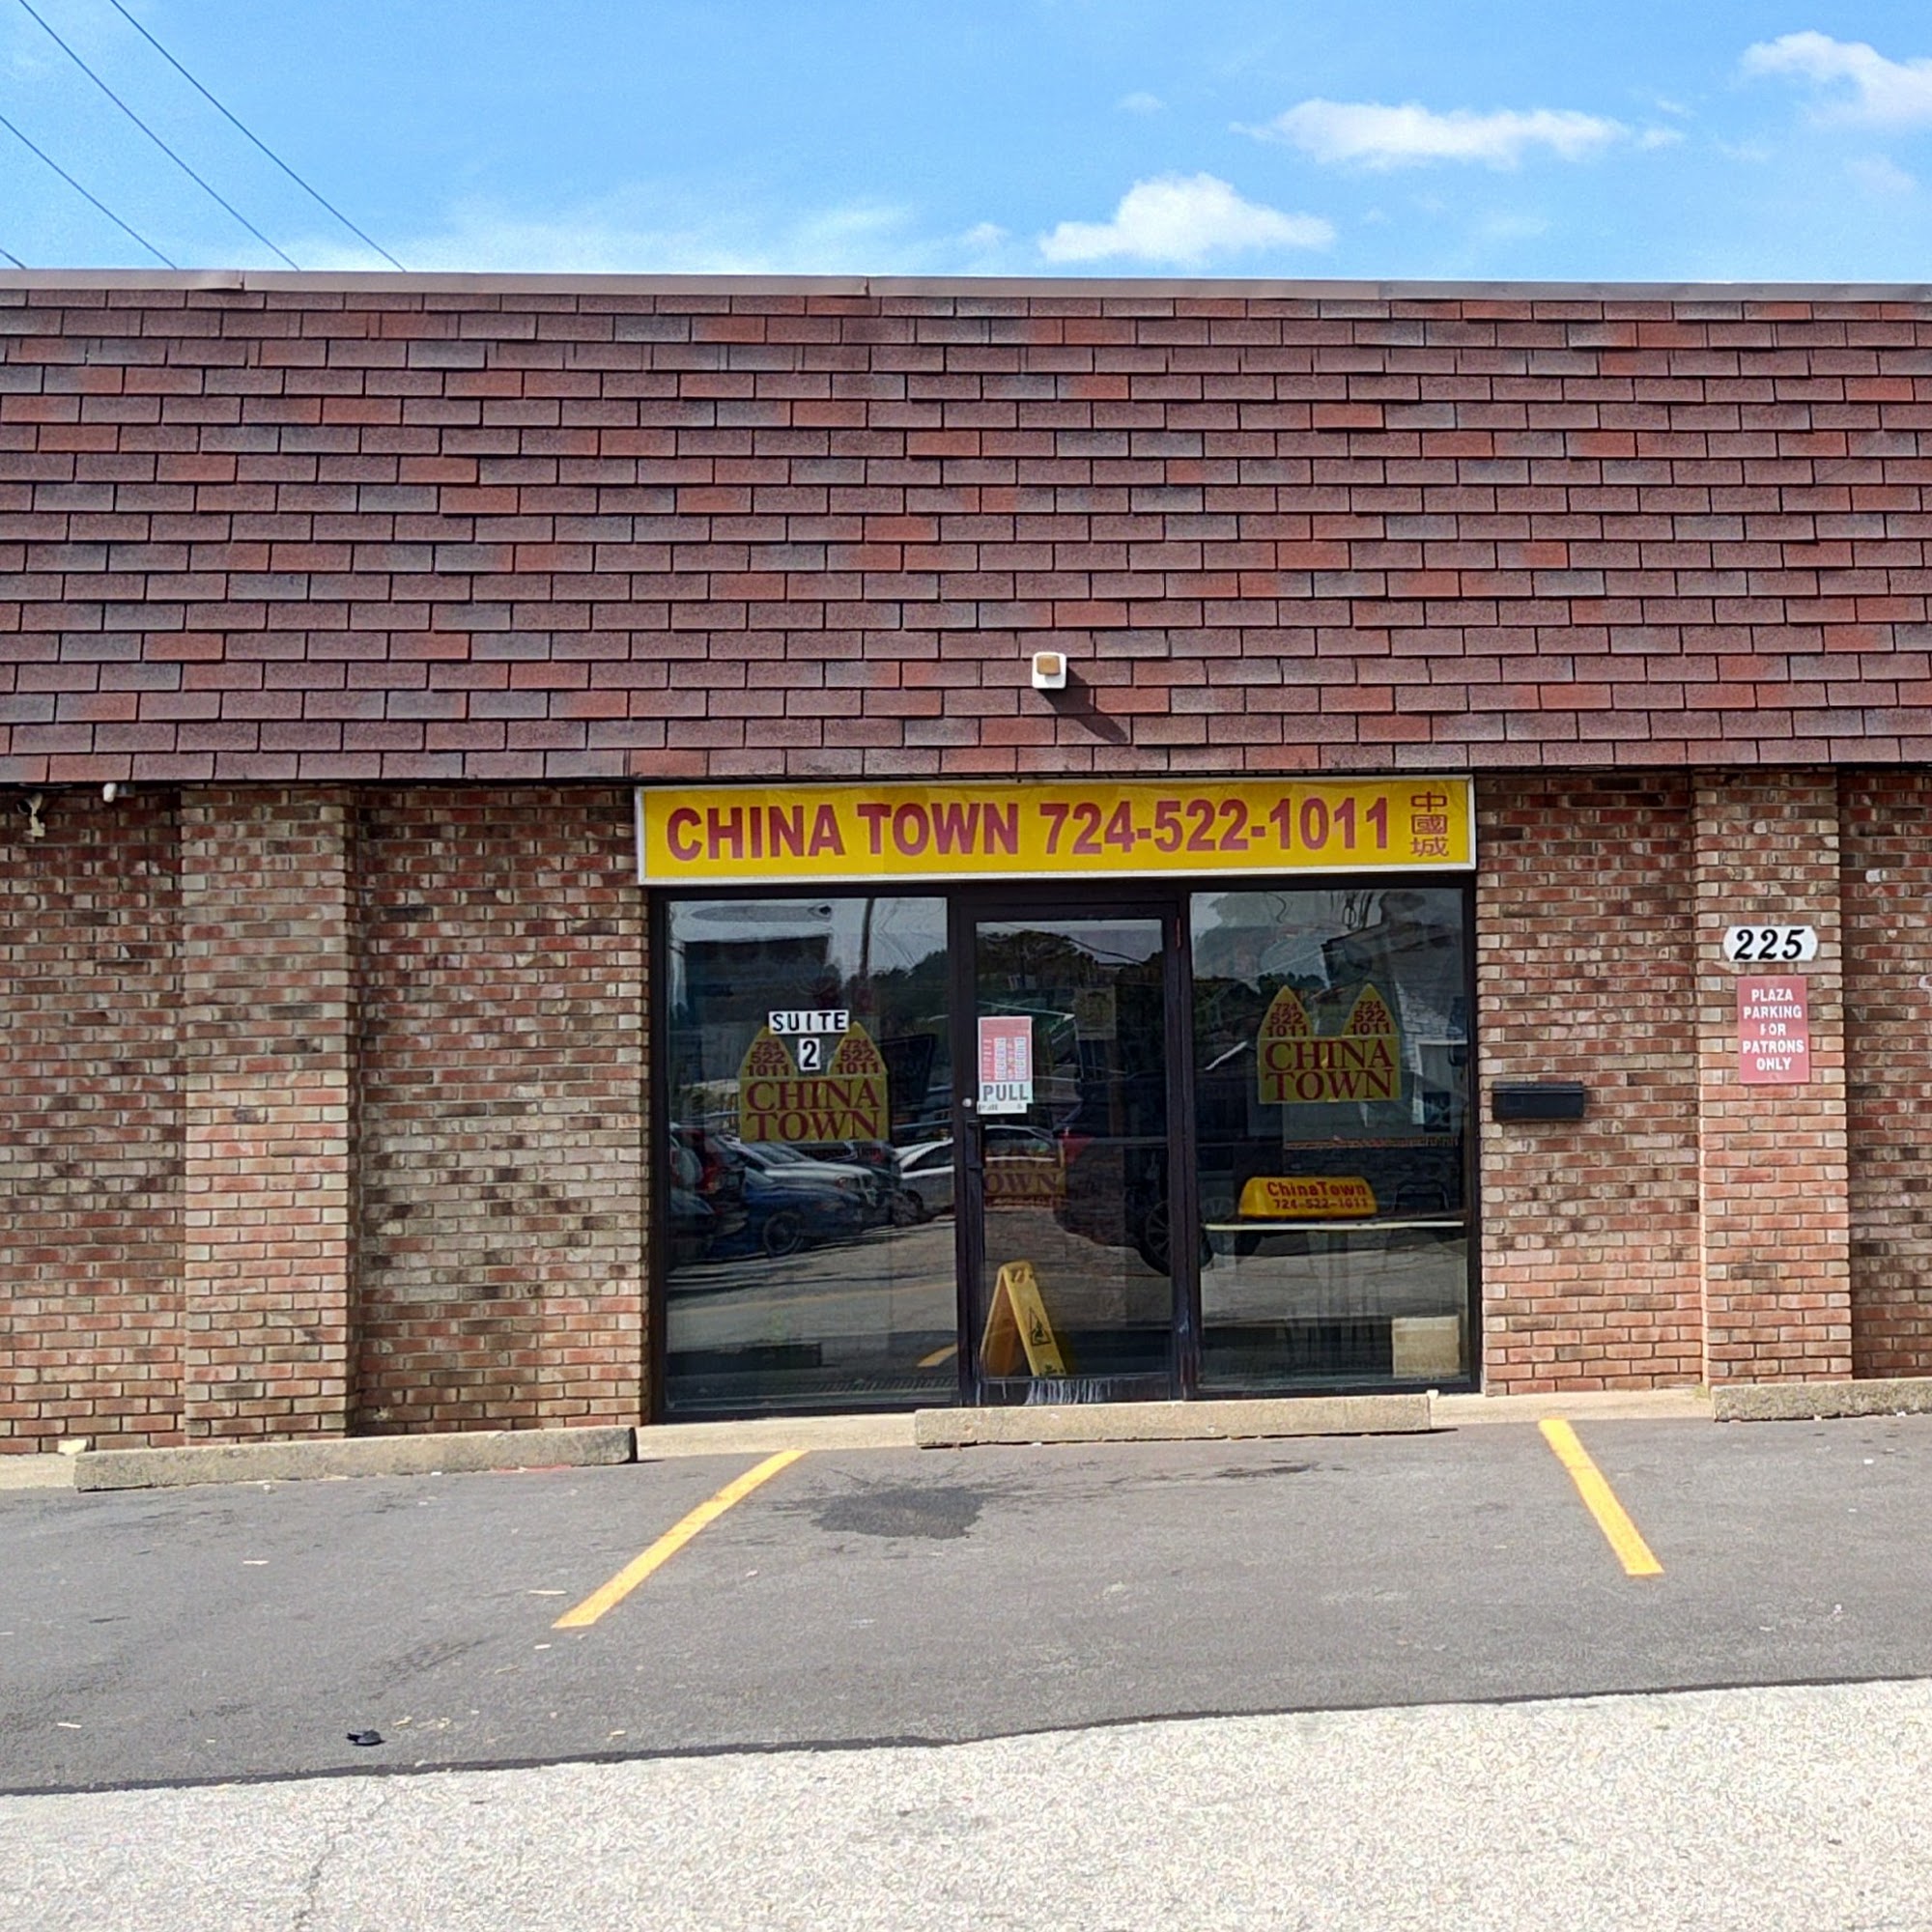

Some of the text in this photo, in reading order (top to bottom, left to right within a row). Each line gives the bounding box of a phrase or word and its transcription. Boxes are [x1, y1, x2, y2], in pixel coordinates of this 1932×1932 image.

[667, 797, 1388, 862] CHINA TOWN 724-522-1011
[1410, 791, 1449, 857] 中國城
[1734, 929, 1804, 960] 225
[1751, 989, 1793, 1002] PLAZA
[1274, 1003, 1297, 1011] 724
[1358, 1001, 1380, 1009] 724
[1270, 1012, 1303, 1025] 522
[1354, 1010, 1386, 1022] 522
[1744, 1005, 1802, 1019] PARKING
[773, 1012, 846, 1032] SUITE
[1350, 1022, 1390, 1035] 1011
[1266, 1025, 1307, 1037] 1011
[755, 1041, 780, 1051] 724
[845, 1039, 868, 1049] 724
[1743, 1039, 1804, 1054] PATRONS
[751, 1051, 784, 1064] 522
[803, 1040, 817, 1067] 2
[840, 1049, 874, 1062] 522
[1264, 1038, 1394, 1071] CHINA
[837, 1062, 880, 1074] 1011
[1756, 1057, 1792, 1070] ONLY
[746, 1064, 789, 1077] 1011
[1265, 1068, 1394, 1101] TOWN
[747, 1079, 880, 1111] CHINA
[983, 1084, 1029, 1101] PULL
[747, 1110, 879, 1142] TOWN
[984, 1173, 1059, 1193] OWN
[1267, 1181, 1367, 1196] ChinaTown
[1274, 1198, 1368, 1209] 724-522-1011
